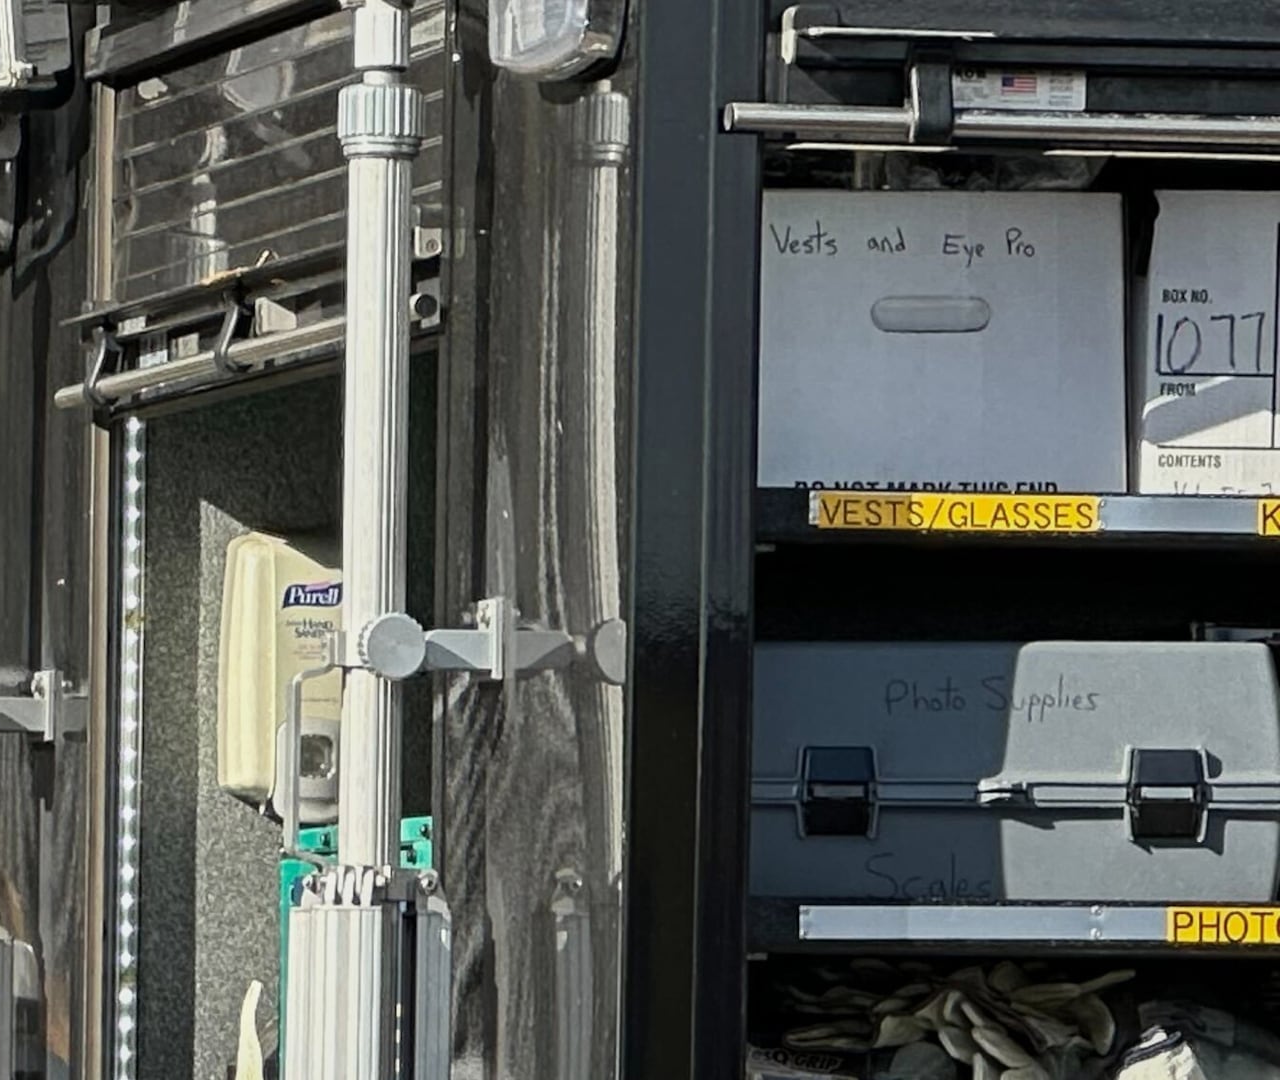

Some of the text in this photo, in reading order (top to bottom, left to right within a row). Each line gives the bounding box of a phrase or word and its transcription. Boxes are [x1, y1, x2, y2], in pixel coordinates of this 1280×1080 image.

[769, 220, 1036, 268] Vests and Eye Pro
[1161, 288, 1187, 303] BOX
[1156, 311, 1266, 374] 1077
[1159, 382, 1196, 397] FROM
[1157, 454, 1222, 468] CONTENTS
[821, 498, 1093, 532] VESTS/GLASSES
[288, 586, 339, 605] Purell
[885, 674, 1101, 723] Photo Supplies
[864, 852, 991, 898] Scales
[1173, 910, 1280, 943] PHOT
